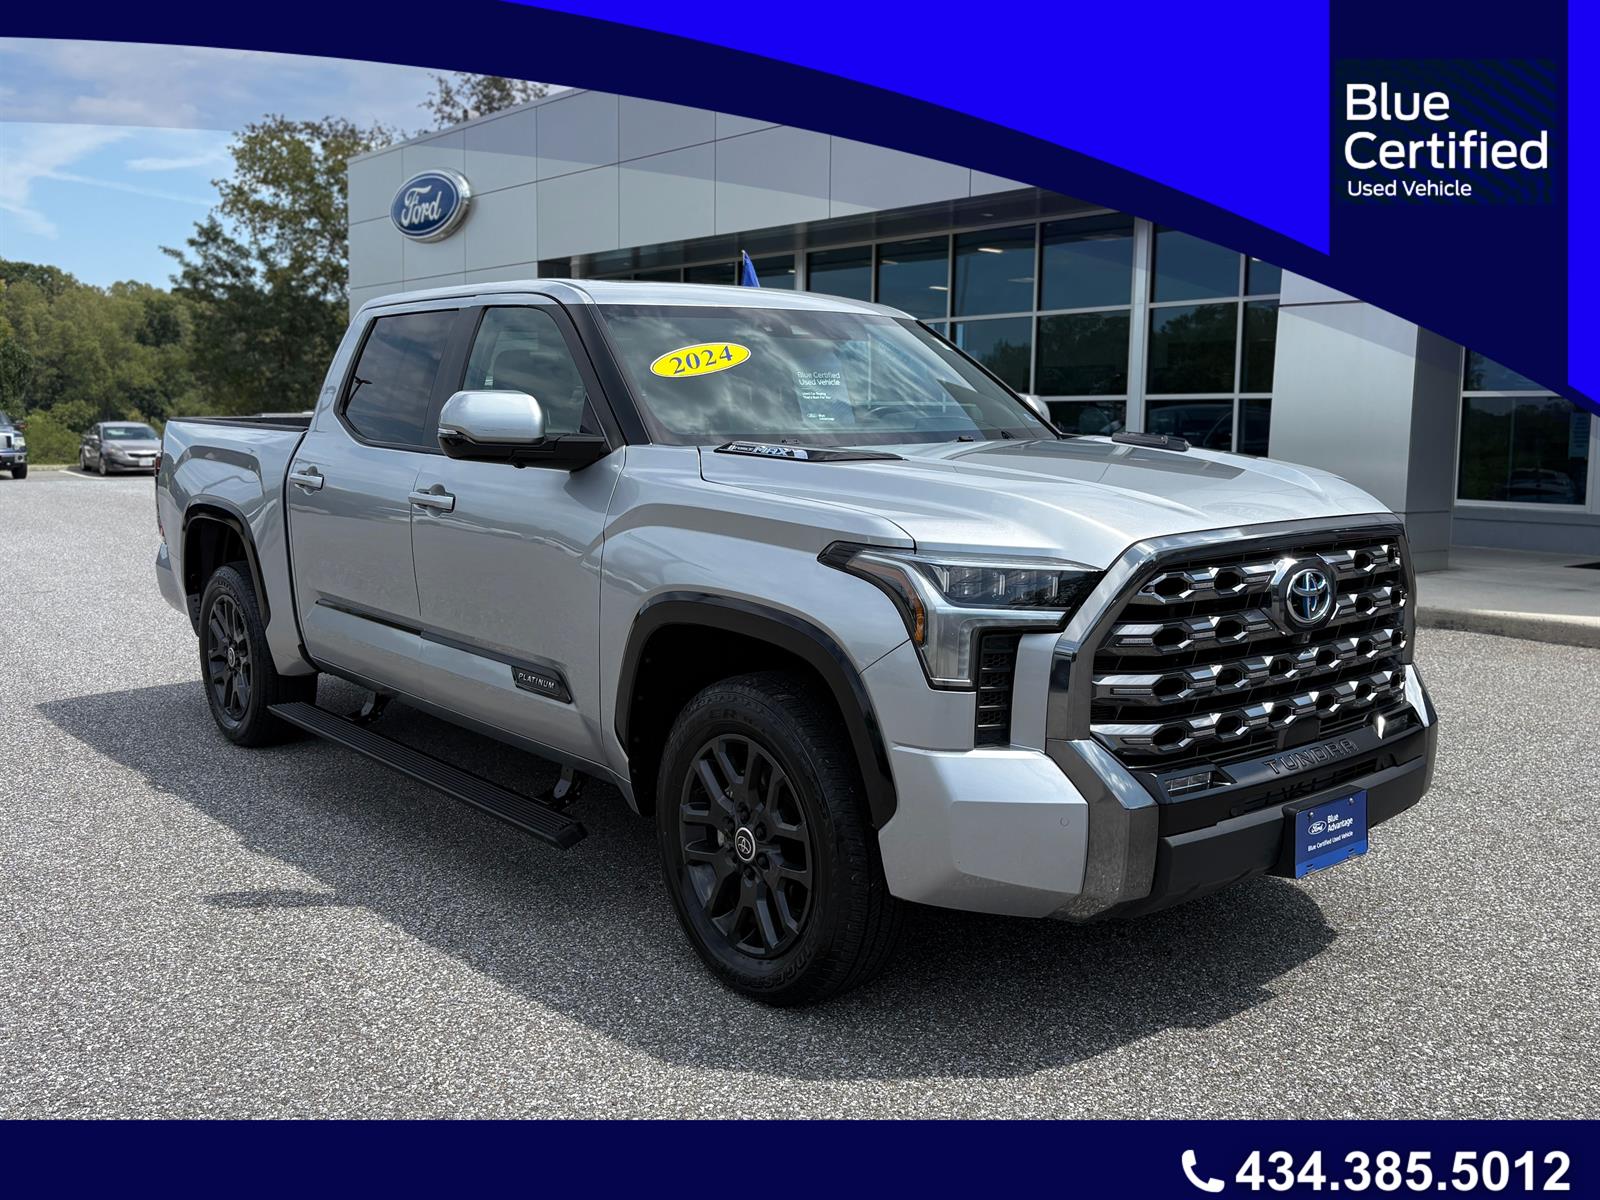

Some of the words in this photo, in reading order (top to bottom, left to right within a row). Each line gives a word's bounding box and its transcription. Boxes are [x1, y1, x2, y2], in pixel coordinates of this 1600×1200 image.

[400, 185, 442, 227] Ford
[668, 345, 734, 375] 2024
[813, 371, 840, 379] Certified
[518, 672, 555, 689] PLATINUM
[1263, 738, 1360, 775] TUNDRA
[1327, 814, 1339, 824] Blue
[1327, 817, 1354, 832] Advantage
